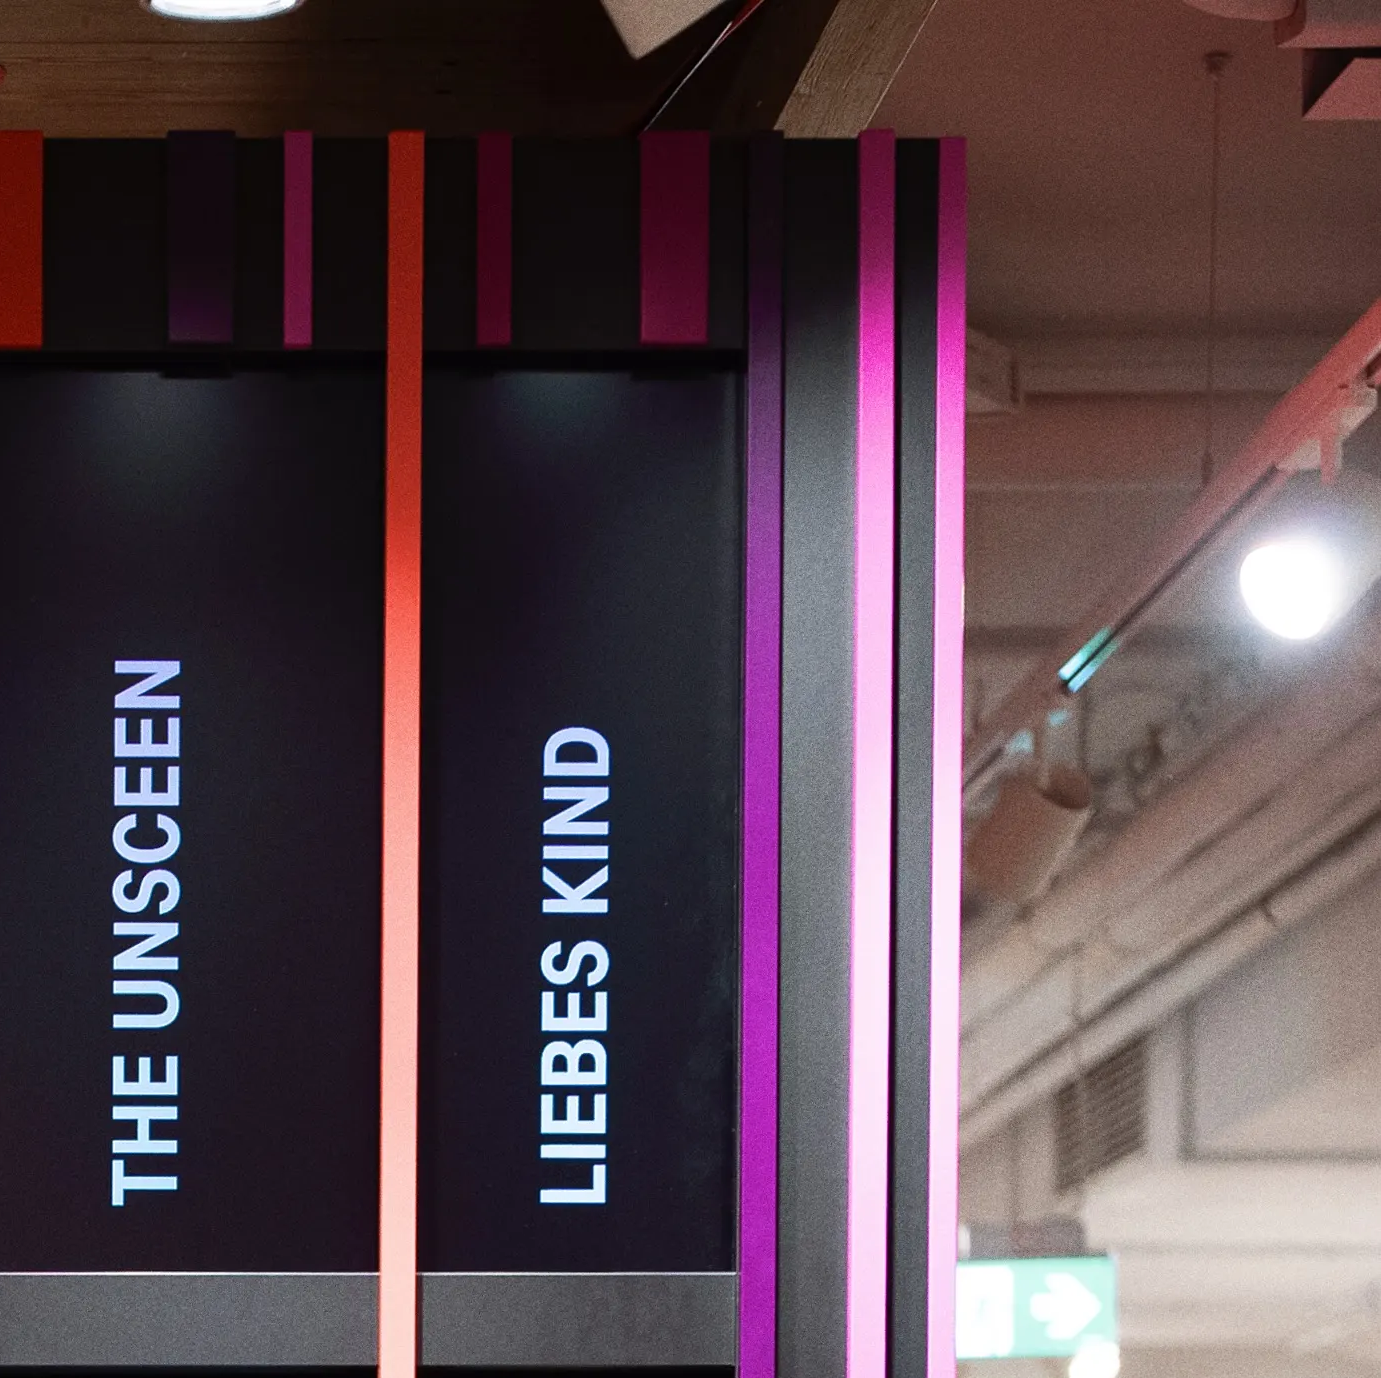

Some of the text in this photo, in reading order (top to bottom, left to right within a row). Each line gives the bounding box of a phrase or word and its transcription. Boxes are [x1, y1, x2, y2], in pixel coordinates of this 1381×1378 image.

[112, 660, 181, 1206] THE UNSCEEN
[540, 726, 610, 1204] LIEBES KIND
